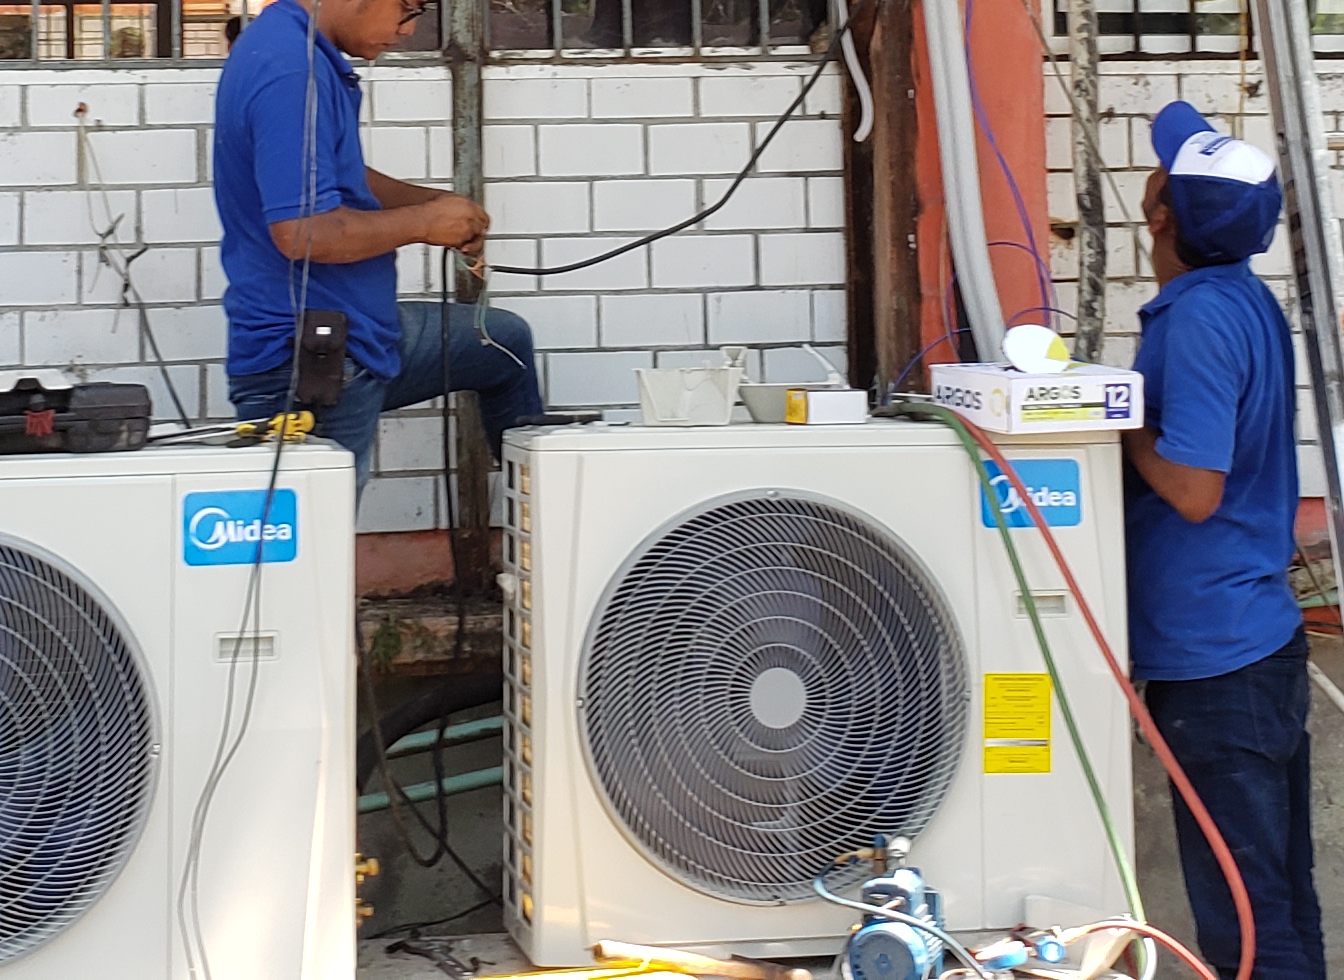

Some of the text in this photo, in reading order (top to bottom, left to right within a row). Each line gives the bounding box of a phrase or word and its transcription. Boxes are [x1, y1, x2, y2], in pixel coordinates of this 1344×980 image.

[935, 384, 982, 410] ARGOS
[1023, 385, 1081, 401] ARGOS
[1106, 385, 1129, 407] 12
[189, 507, 293, 550] Midea
